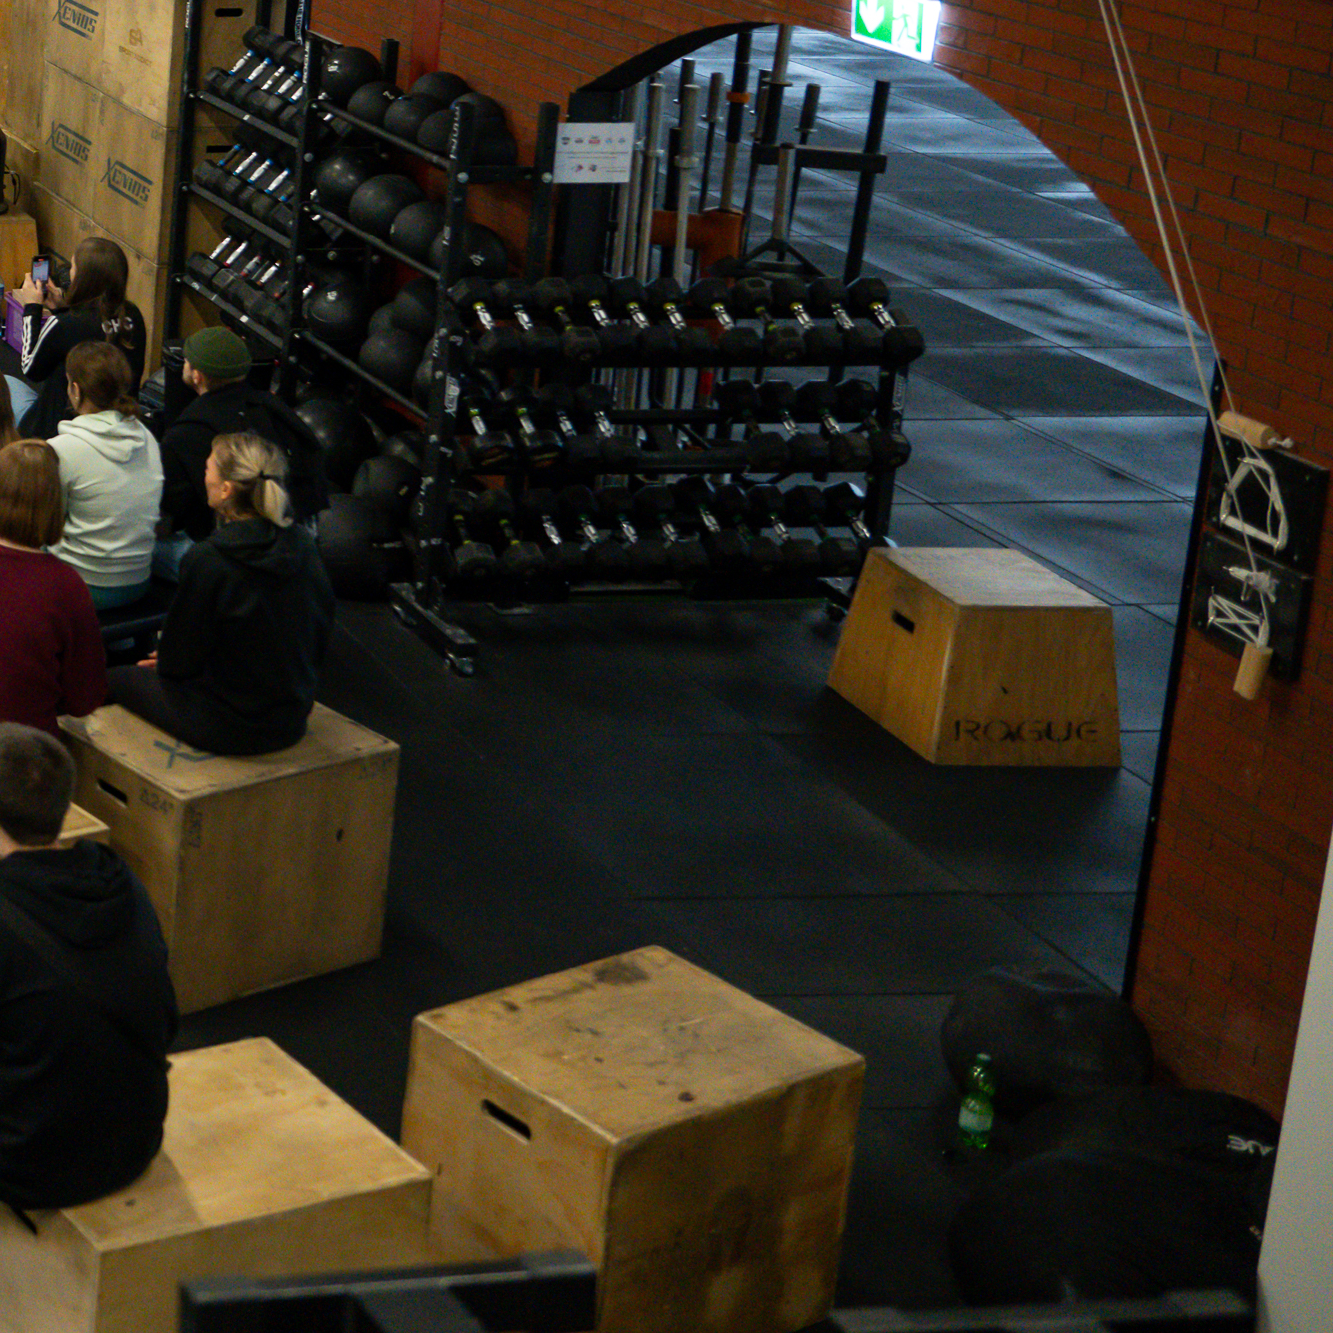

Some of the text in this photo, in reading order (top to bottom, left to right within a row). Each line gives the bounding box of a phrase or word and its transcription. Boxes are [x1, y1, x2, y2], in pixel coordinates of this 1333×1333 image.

[45, 120, 92, 167] XENIOS
[100, 156, 154, 208] XENIOS
[953, 719, 1100, 744] ROGUE
